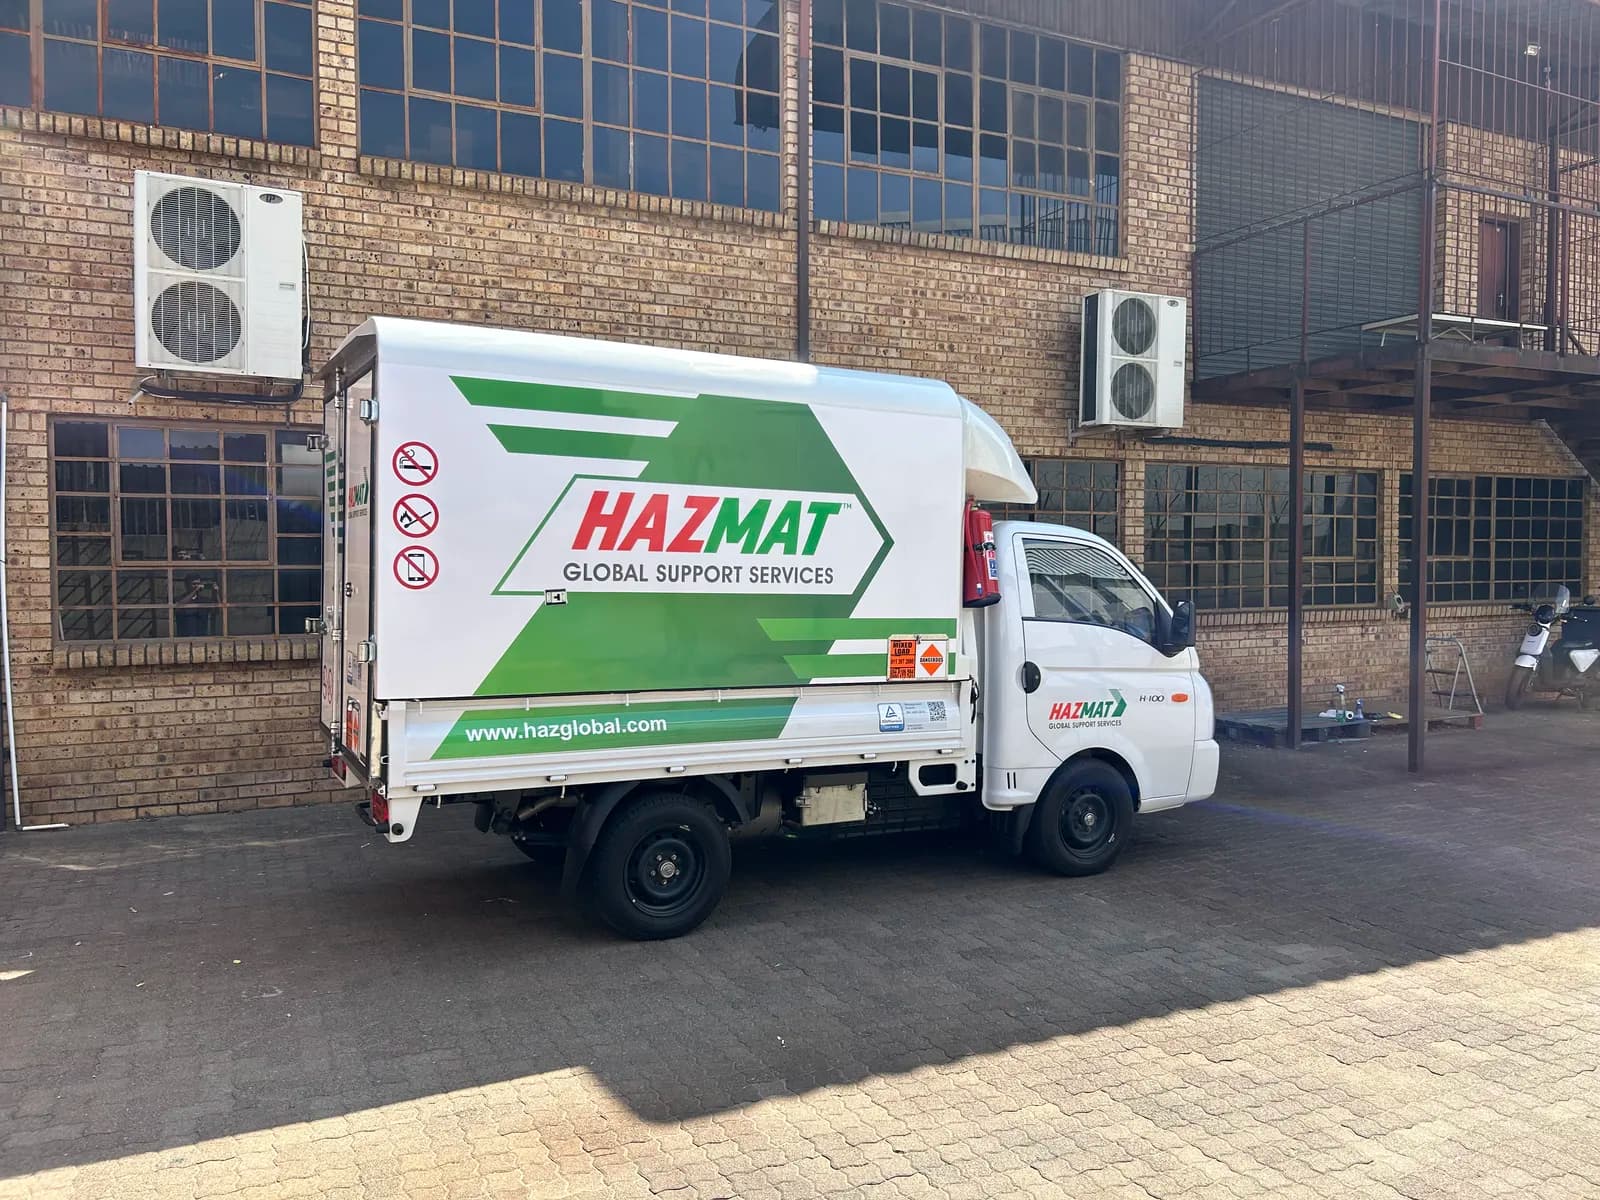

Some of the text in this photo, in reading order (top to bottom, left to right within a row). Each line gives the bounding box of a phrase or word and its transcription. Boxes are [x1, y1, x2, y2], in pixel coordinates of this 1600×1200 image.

[571, 490, 842, 556] HAZMAT
[563, 562, 834, 585] GLOBAL SUPPORT SERVICES
[1049, 701, 1114, 720] HAZMAT
[465, 717, 668, 742] www.hazglobal.com
[1049, 719, 1122, 730] GLOBAL SUPPORT SERVICES
